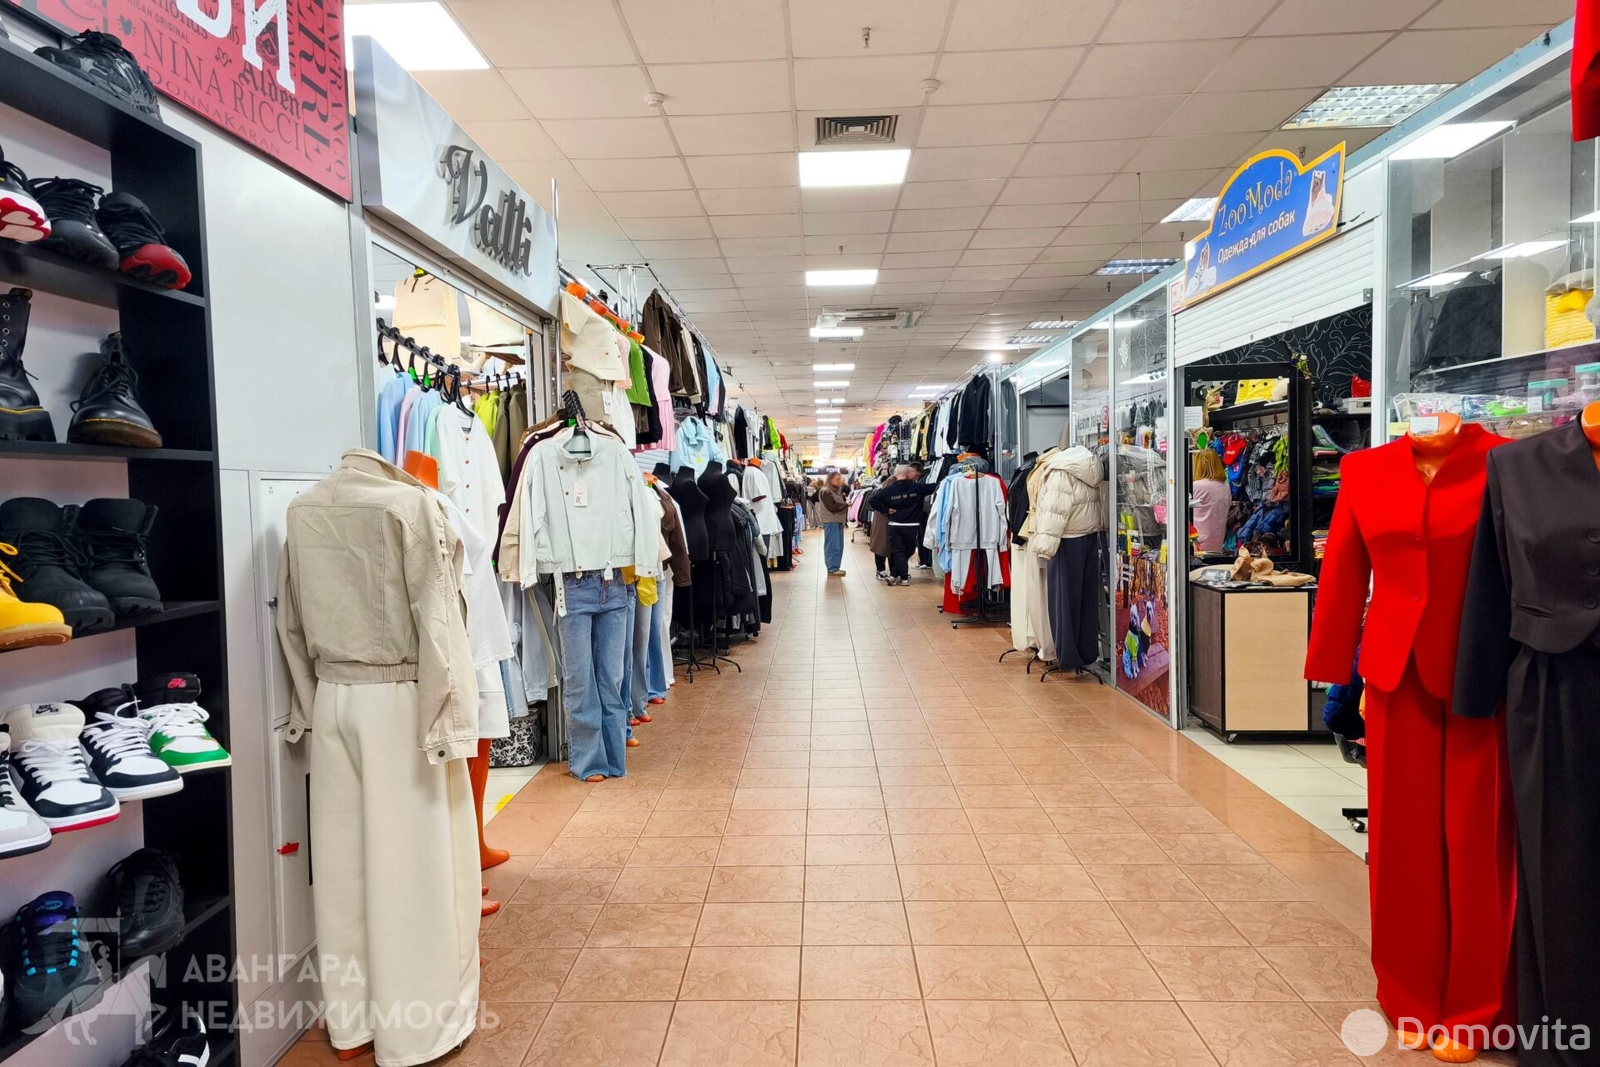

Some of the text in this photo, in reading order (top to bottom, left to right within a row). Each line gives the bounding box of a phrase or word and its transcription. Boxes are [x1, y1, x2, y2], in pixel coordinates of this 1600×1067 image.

[154, 13, 190, 44] ORIGINAL
[140, 19, 225, 105] NINA
[231, 78, 301, 150] RICCI
[1217, 208, 1296, 264] Одежда для собак
